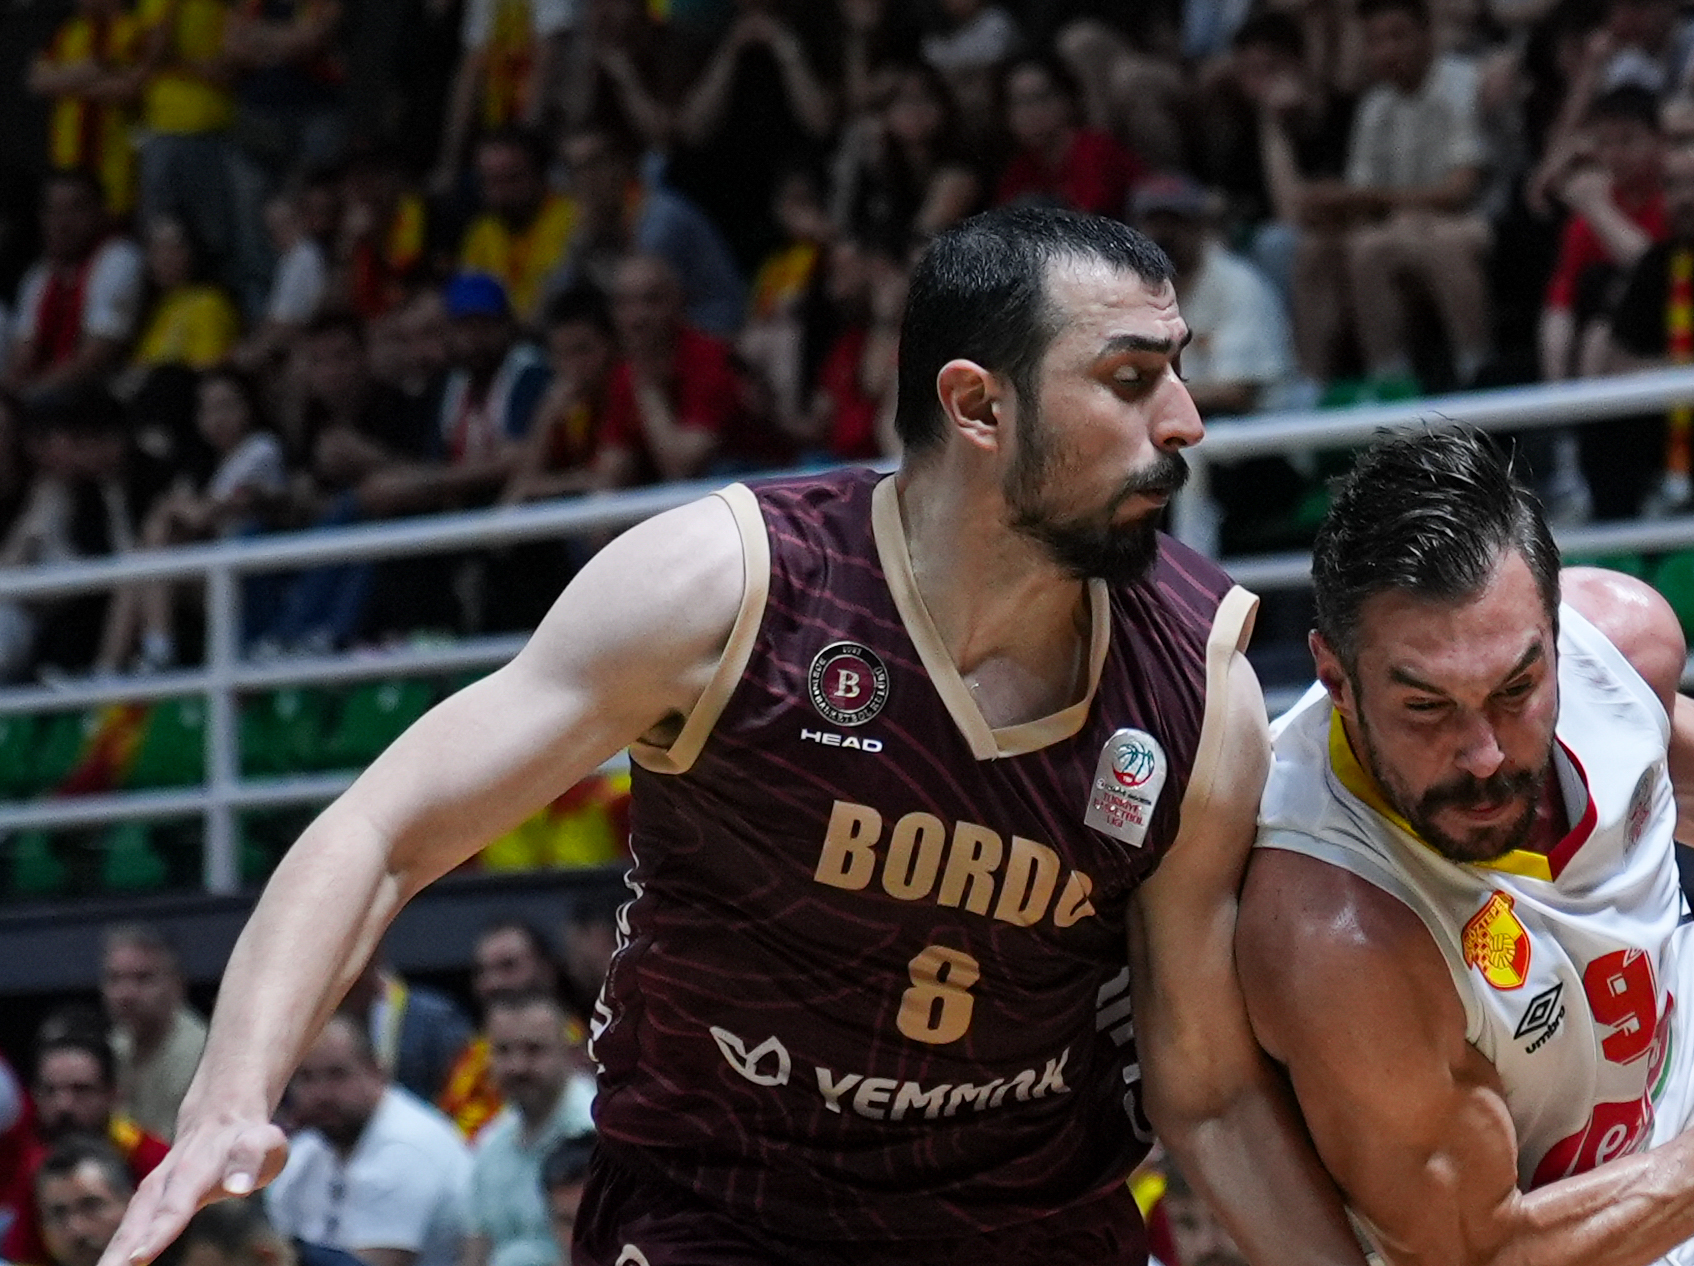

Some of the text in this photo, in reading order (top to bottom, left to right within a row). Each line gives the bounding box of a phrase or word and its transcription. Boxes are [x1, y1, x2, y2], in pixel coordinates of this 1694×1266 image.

[833, 668, 861, 698] B
[800, 728, 884, 754] HEAD
[896, 944, 981, 1046] 8
[1583, 947, 1660, 1067] 9
[1525, 1004, 1566, 1055] umbro
[814, 1046, 1072, 1121] YEMMAK
